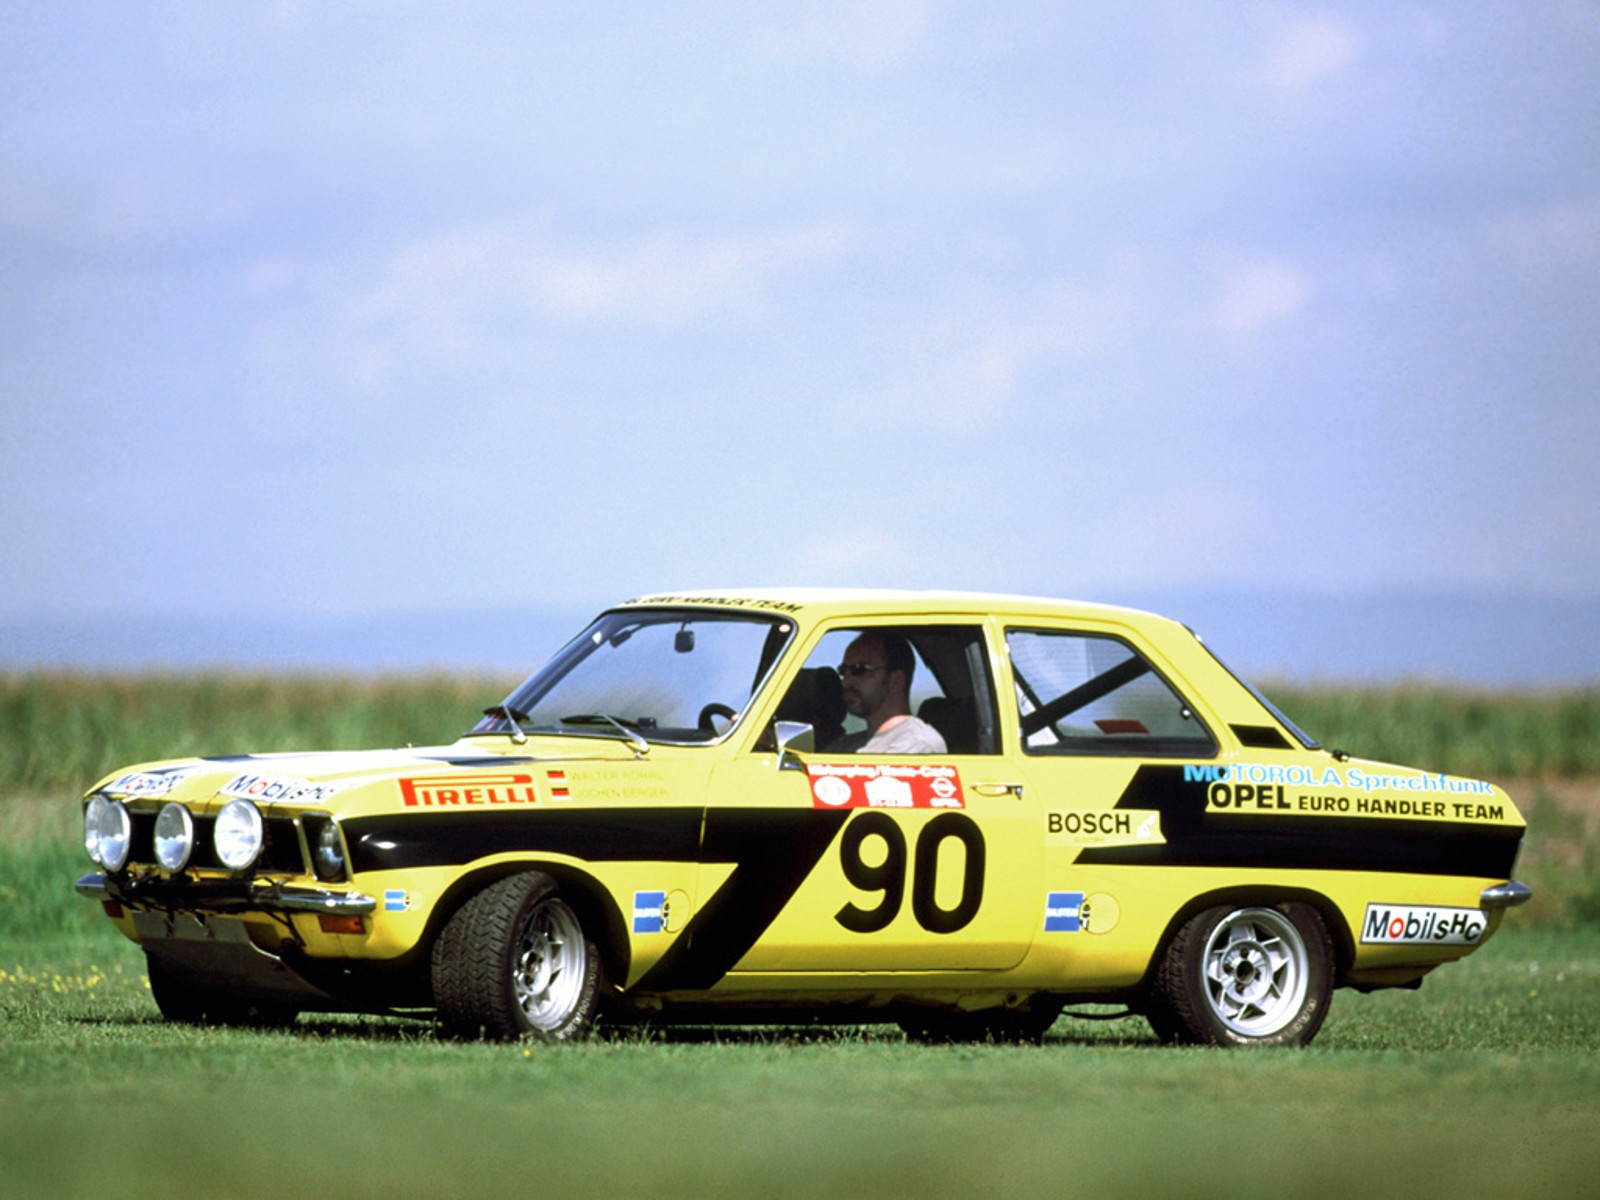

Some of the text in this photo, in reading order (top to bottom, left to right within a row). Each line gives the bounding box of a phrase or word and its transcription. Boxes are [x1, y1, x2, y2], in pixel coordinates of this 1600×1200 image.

[753, 599, 804, 613] TEAM
[398, 774, 536, 806] PIRELLI
[1183, 765, 1495, 795] MOTOROLA Sprechfunk
[1210, 783, 1505, 820] OPEL EURO HANDLER TEAM
[1048, 813, 1130, 834] BOSCH
[834, 811, 986, 934] 90
